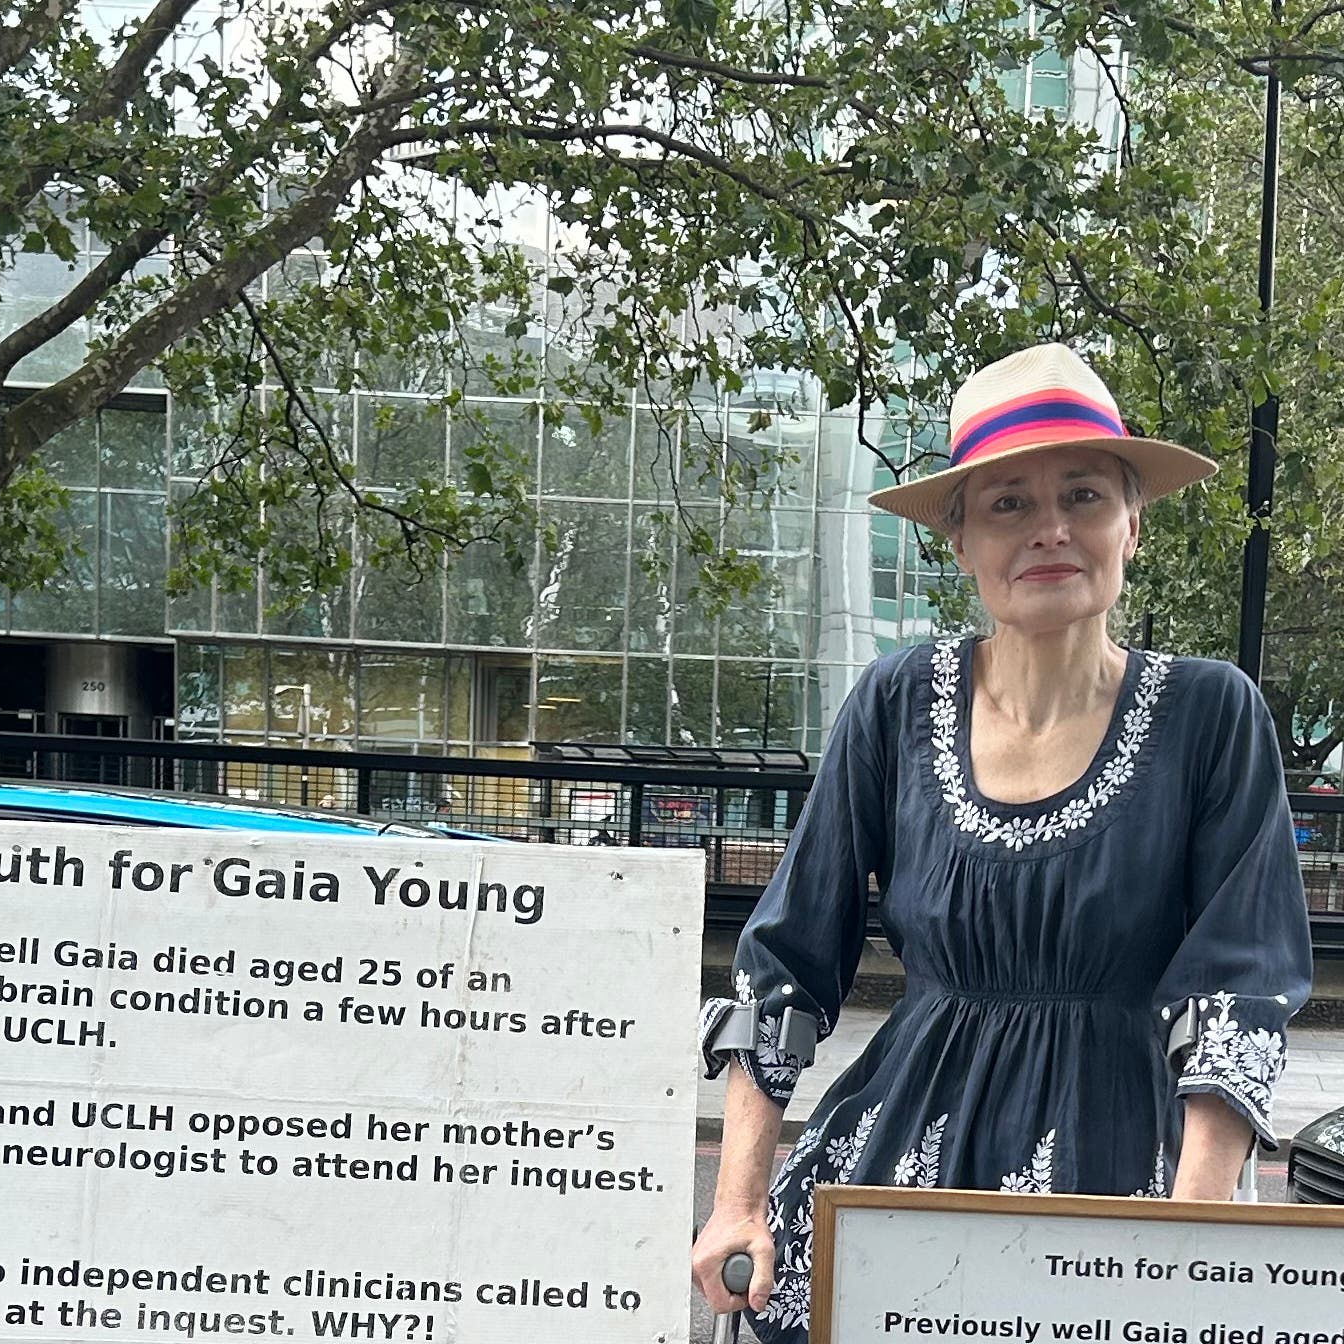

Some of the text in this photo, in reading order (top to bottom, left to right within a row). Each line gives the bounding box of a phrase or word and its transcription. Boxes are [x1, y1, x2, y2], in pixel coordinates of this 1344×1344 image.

[82, 682, 105, 692] 250
[109, 850, 193, 893] for
[213, 857, 340, 903] Gaia
[363, 865, 545, 924] Young
[54, 941, 137, 970] Gaia
[153, 946, 235, 976] died
[250, 957, 343, 987] aged
[359, 959, 401, 986] 25
[417, 963, 455, 989] of
[468, 971, 512, 992] an
[4, 1016, 116, 1047] UCLH.
[110, 988, 288, 1019] condition
[304, 1001, 323, 1021] a
[338, 997, 406, 1026] few
[421, 1001, 526, 1033] hours
[541, 1010, 635, 1039] after
[72, 1102, 173, 1131] UCLH
[189, 1113, 352, 1141] opposed
[368, 1114, 429, 1142] her
[3, 1142, 226, 1178] neurologist
[239, 1150, 278, 1175] to
[293, 1153, 417, 1181] attend
[434, 1156, 497, 1184] her
[511, 1160, 663, 1195] inquest.
[21, 1258, 270, 1295] independent
[284, 1270, 462, 1302] clinicians
[477, 1279, 588, 1308] called
[603, 1285, 641, 1313] to
[1045, 1252, 1123, 1278] Truth
[1134, 1258, 1178, 1280] for
[1188, 1261, 1253, 1283] Gaia
[5, 1301, 44, 1325] at
[58, 1300, 121, 1328] the
[138, 1303, 294, 1338] inquest.
[312, 1311, 433, 1340] WHY?!
[885, 1312, 1041, 1343] Previously
[1052, 1319, 1111, 1341] well
[1123, 1321, 1187, 1344] Gaia
